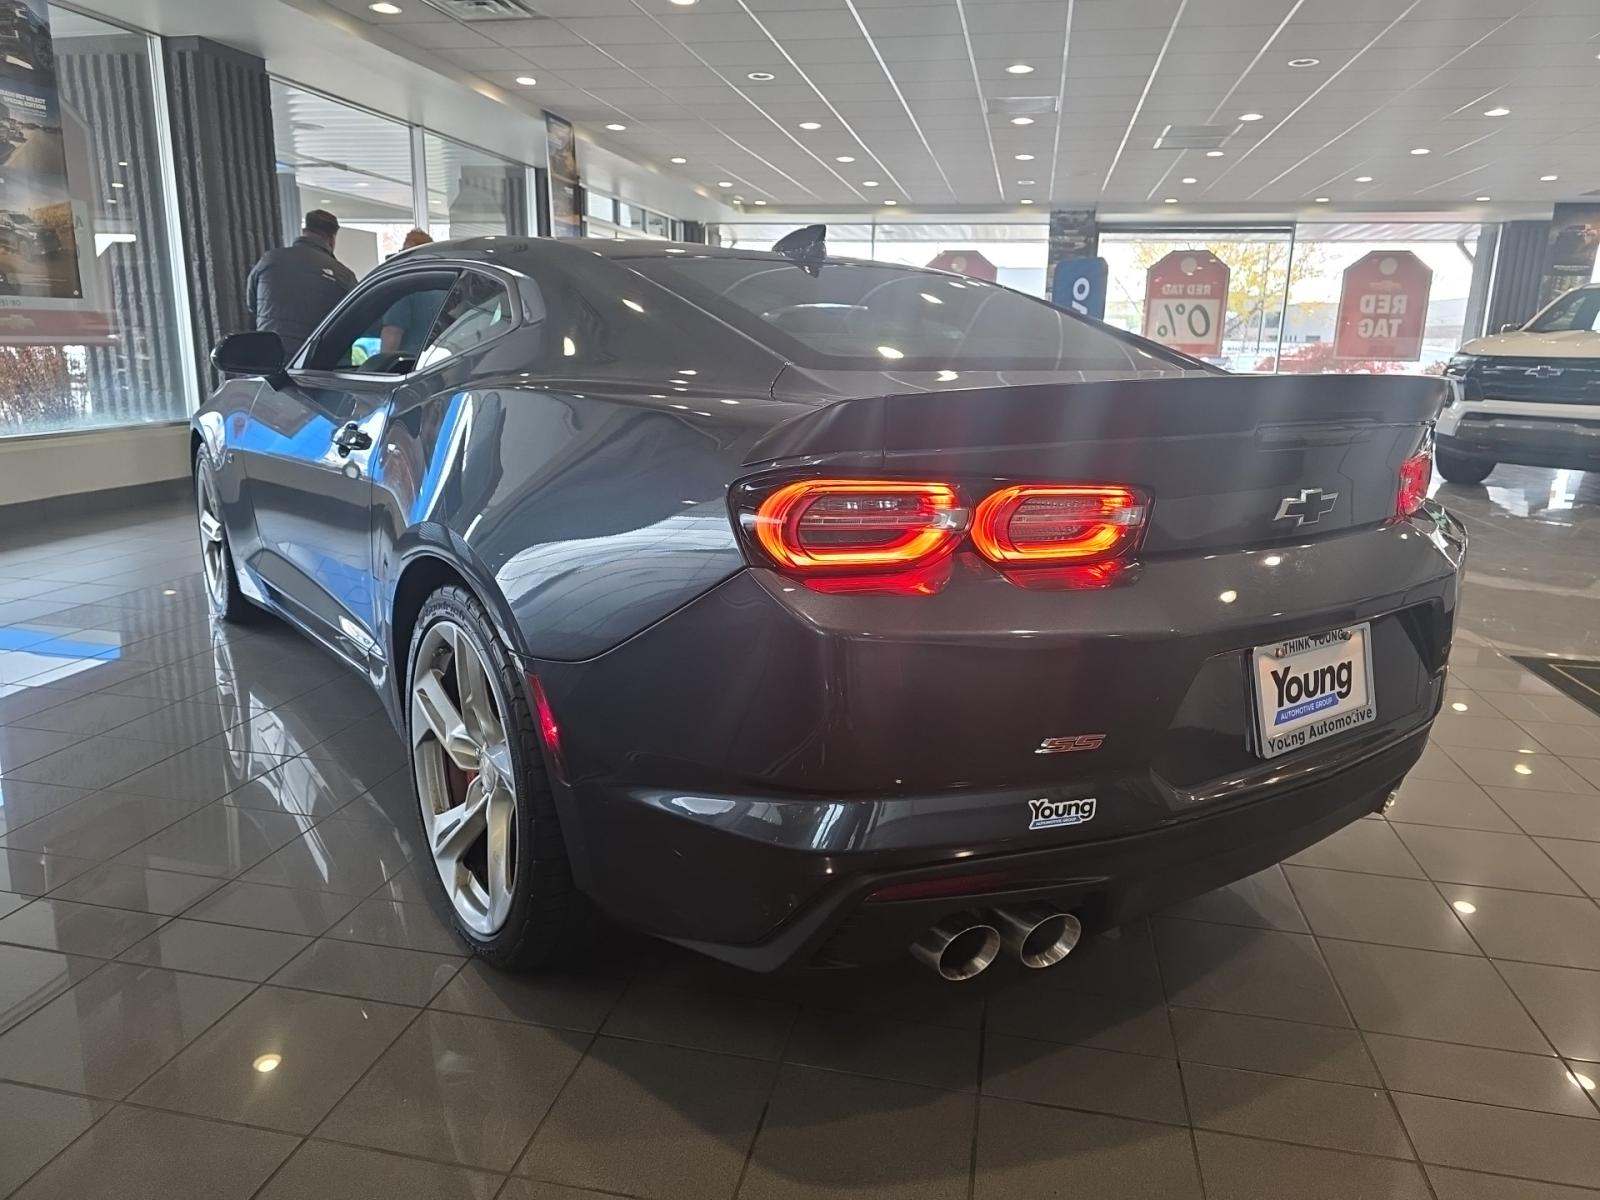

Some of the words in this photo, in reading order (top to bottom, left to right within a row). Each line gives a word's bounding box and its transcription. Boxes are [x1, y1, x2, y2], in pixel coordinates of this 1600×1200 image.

[1282, 638, 1310, 655] THINK
[1271, 660, 1353, 708] Young
[1280, 702, 1314, 721] AUTOMOTIVE
[1315, 696, 1333, 710] GROUP
[1034, 734, 1106, 753] SS
[1030, 799, 1095, 820] Young
